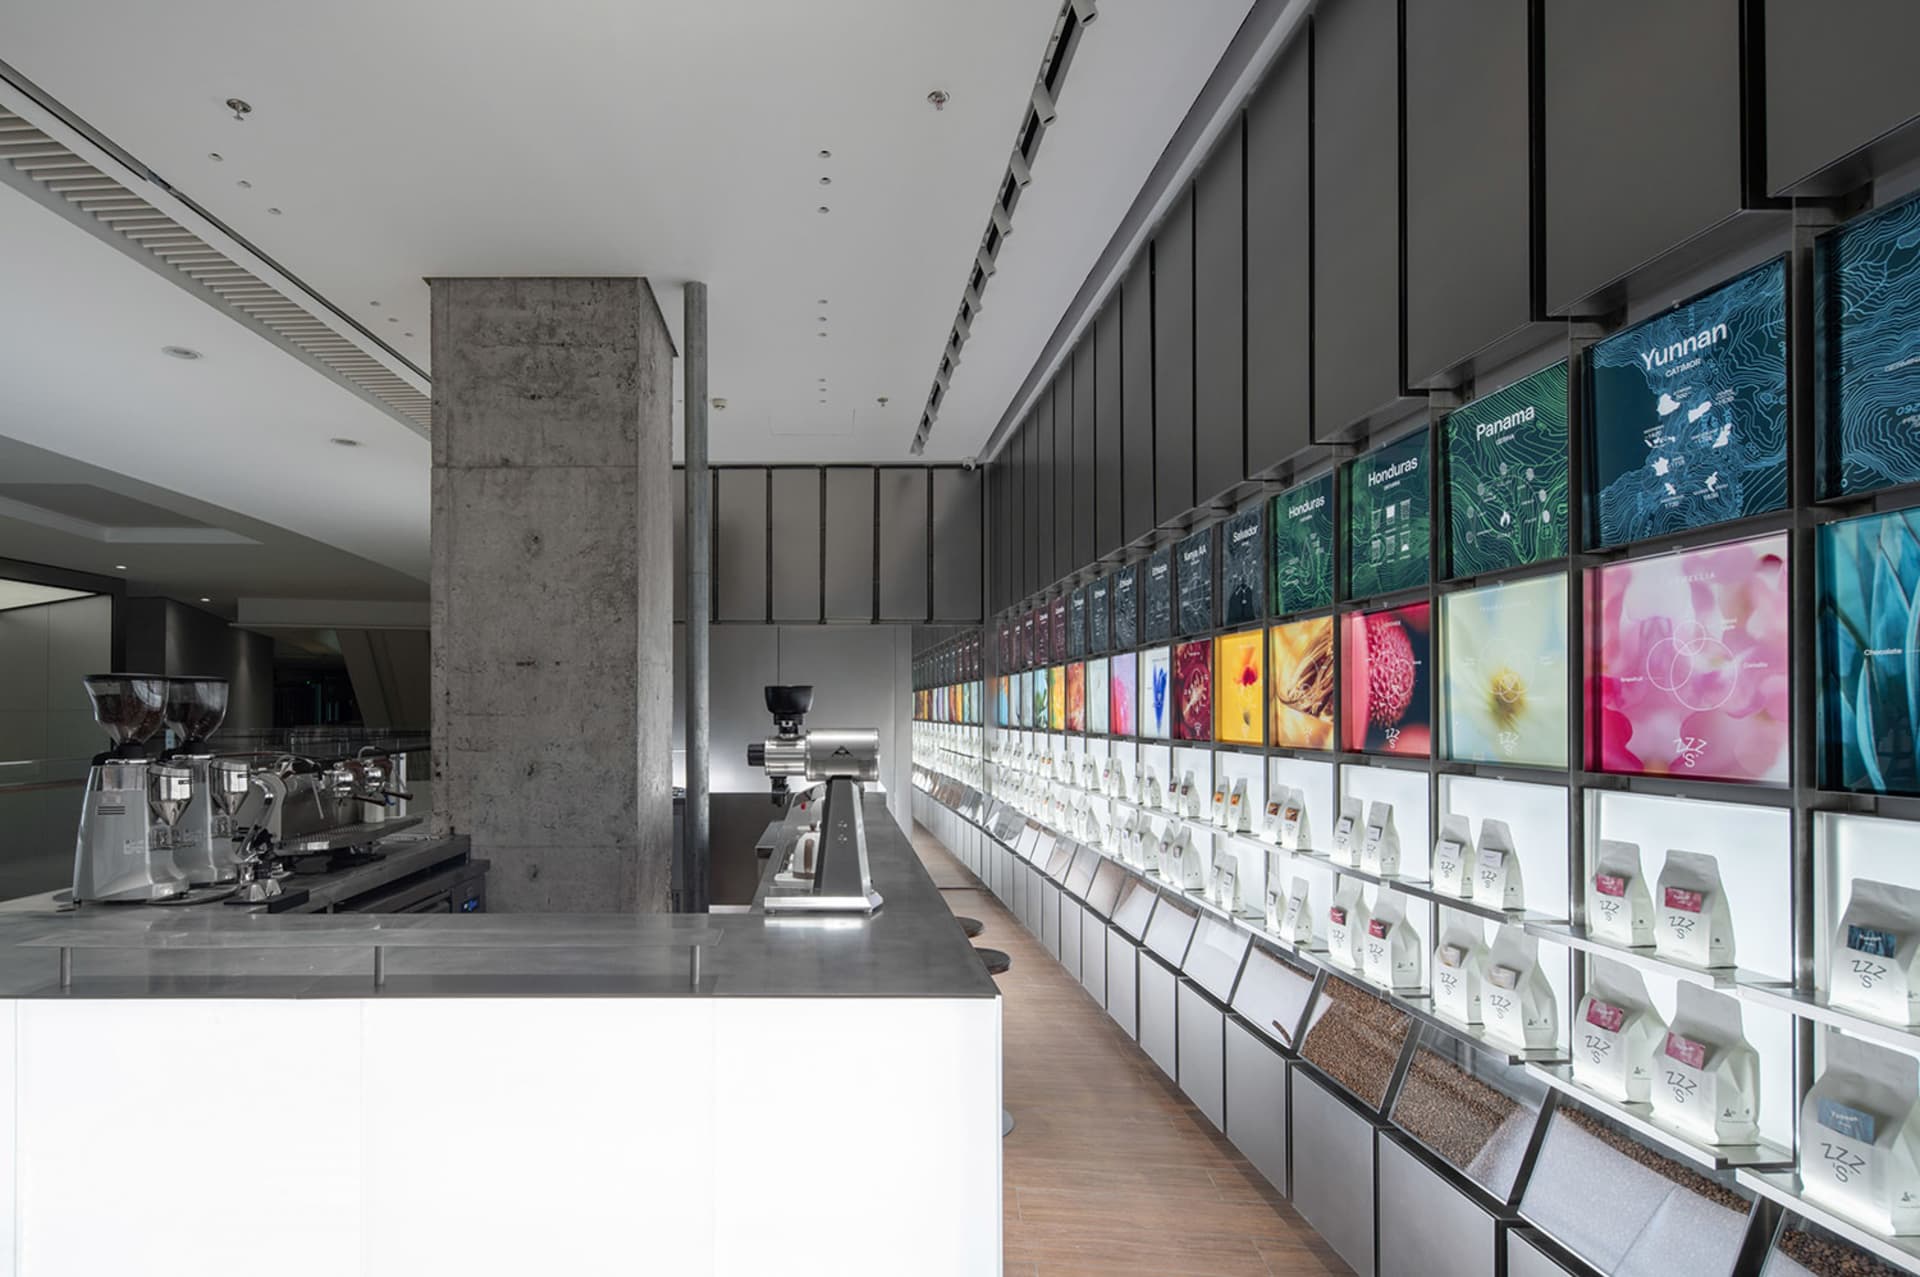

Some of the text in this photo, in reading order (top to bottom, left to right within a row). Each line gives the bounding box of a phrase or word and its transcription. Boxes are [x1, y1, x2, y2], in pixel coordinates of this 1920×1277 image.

[1641, 323, 1727, 370] Yunnan
[1476, 406, 1535, 441] Panama
[1368, 457, 1418, 487] Honduras
[1288, 495, 1325, 519] Honduras
[1673, 736, 1708, 755] ZZZ
[1668, 915, 1695, 932] ZZZ
[1851, 959, 1887, 980] ZZZ
[1585, 1035, 1611, 1056] ZZZ
[1665, 1071, 1697, 1095] ZZZ
[1820, 1142, 1866, 1175] ZZZ
